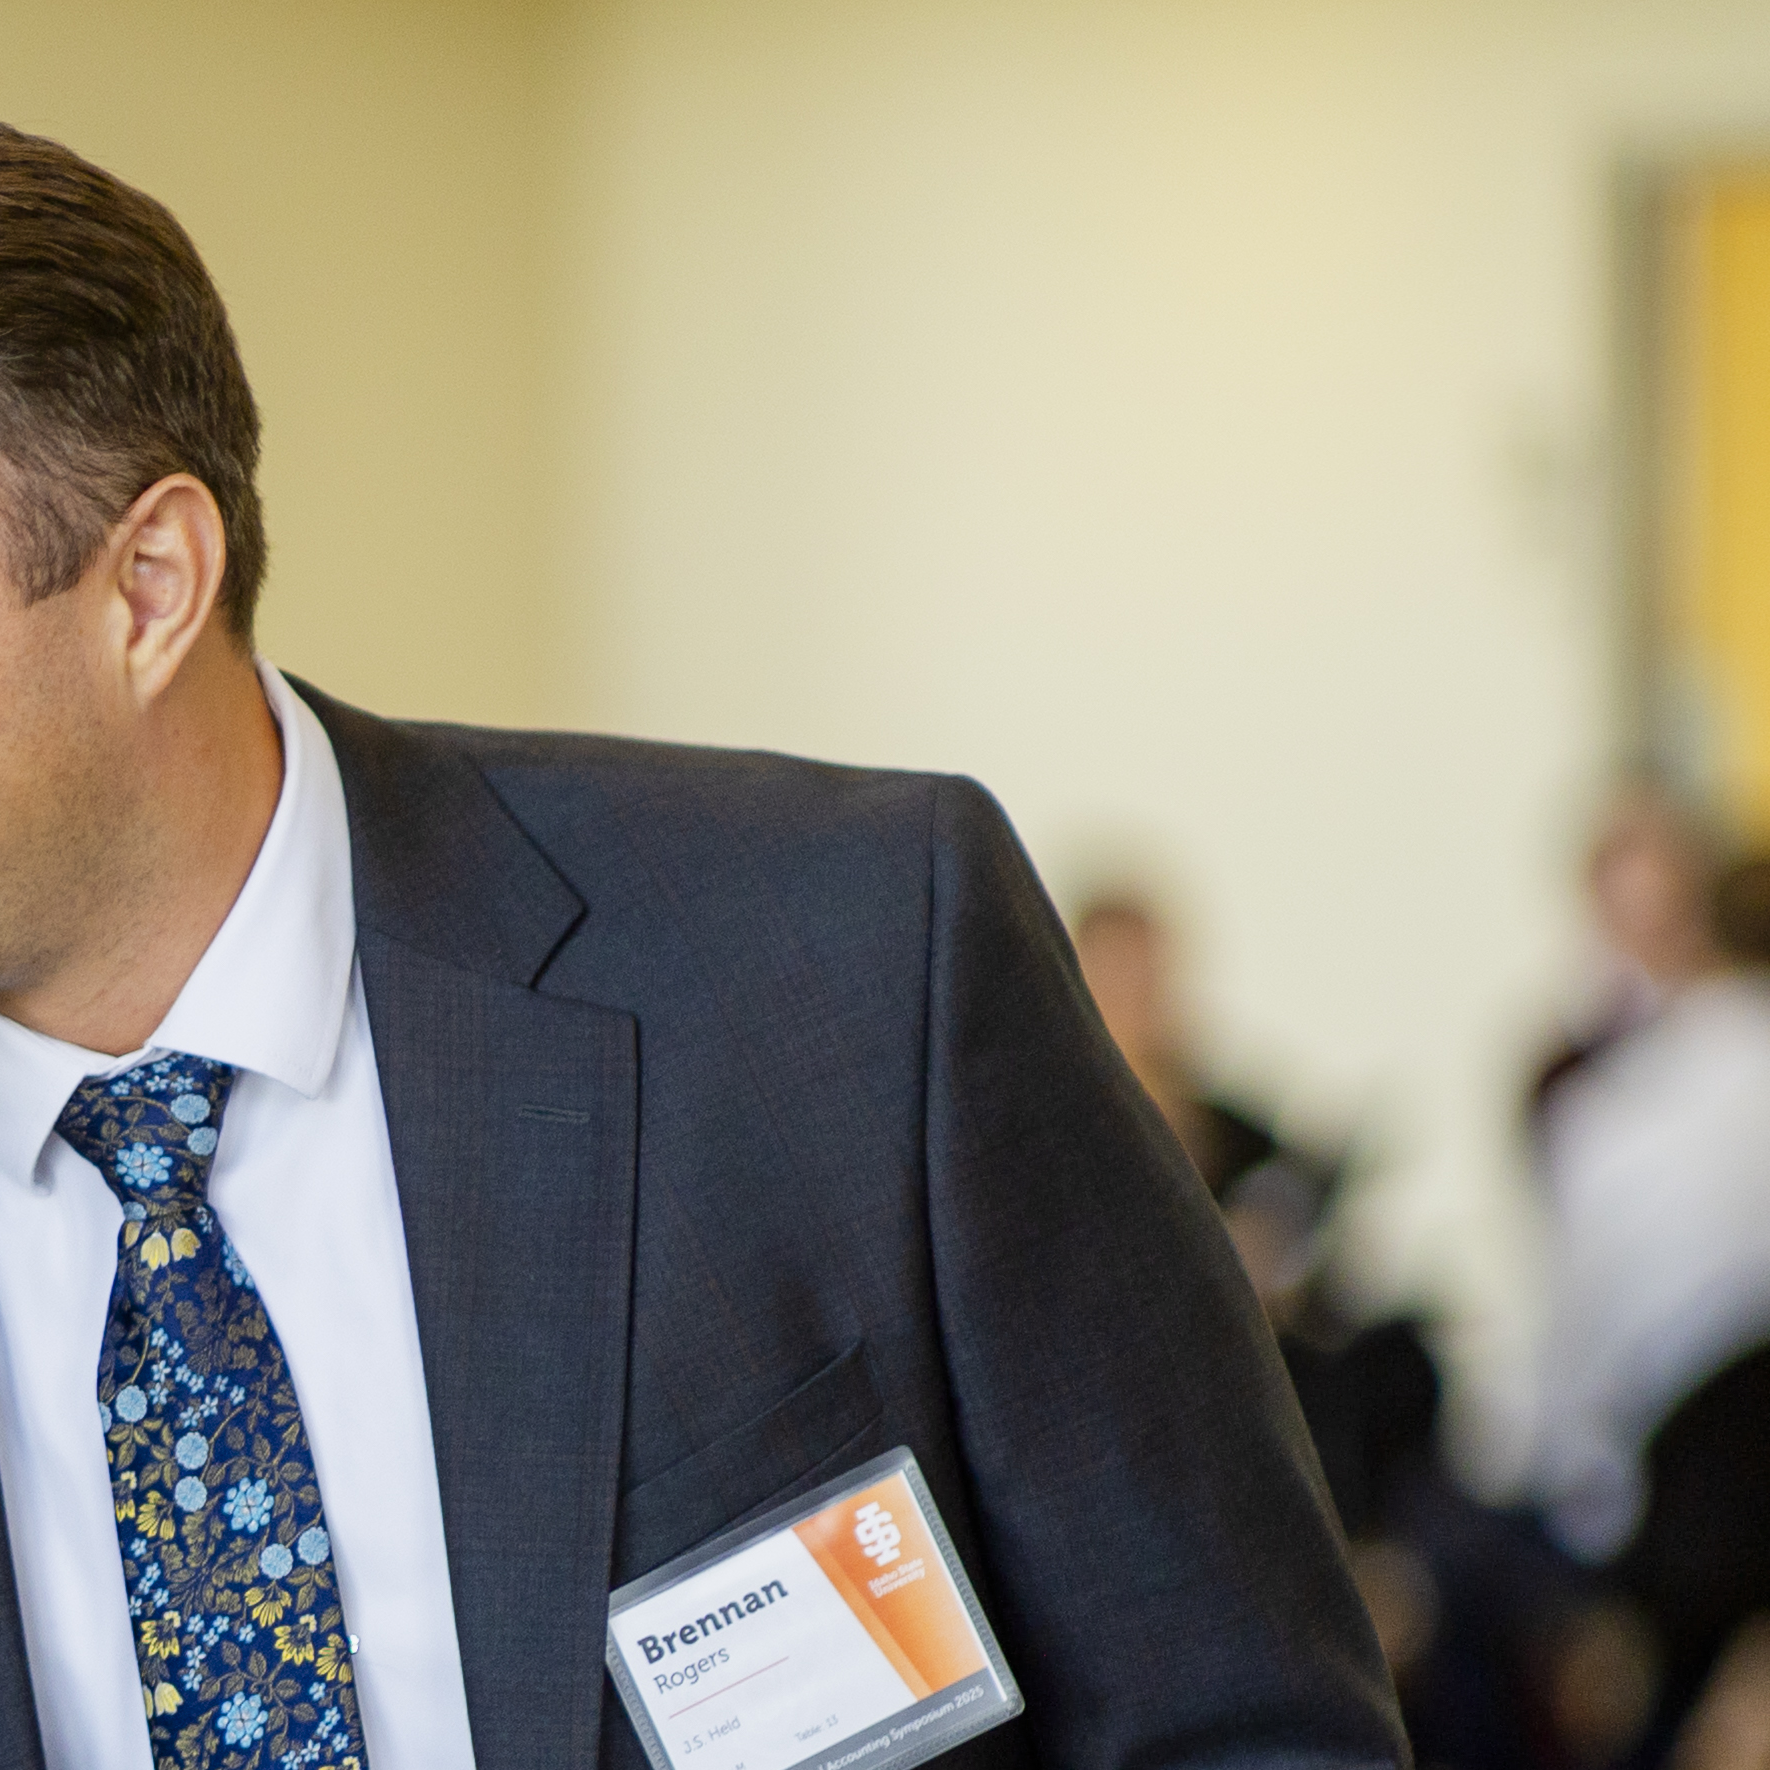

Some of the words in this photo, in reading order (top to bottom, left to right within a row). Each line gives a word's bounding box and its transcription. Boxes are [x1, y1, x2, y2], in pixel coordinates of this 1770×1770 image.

[637, 1579, 789, 1664] Brennan
[653, 1647, 730, 1694] Rogers
[683, 1735, 707, 1754] J.S.
[708, 1715, 741, 1741] Held
[889, 1702, 955, 1741] Symposium
[954, 1684, 985, 1709] 2025
